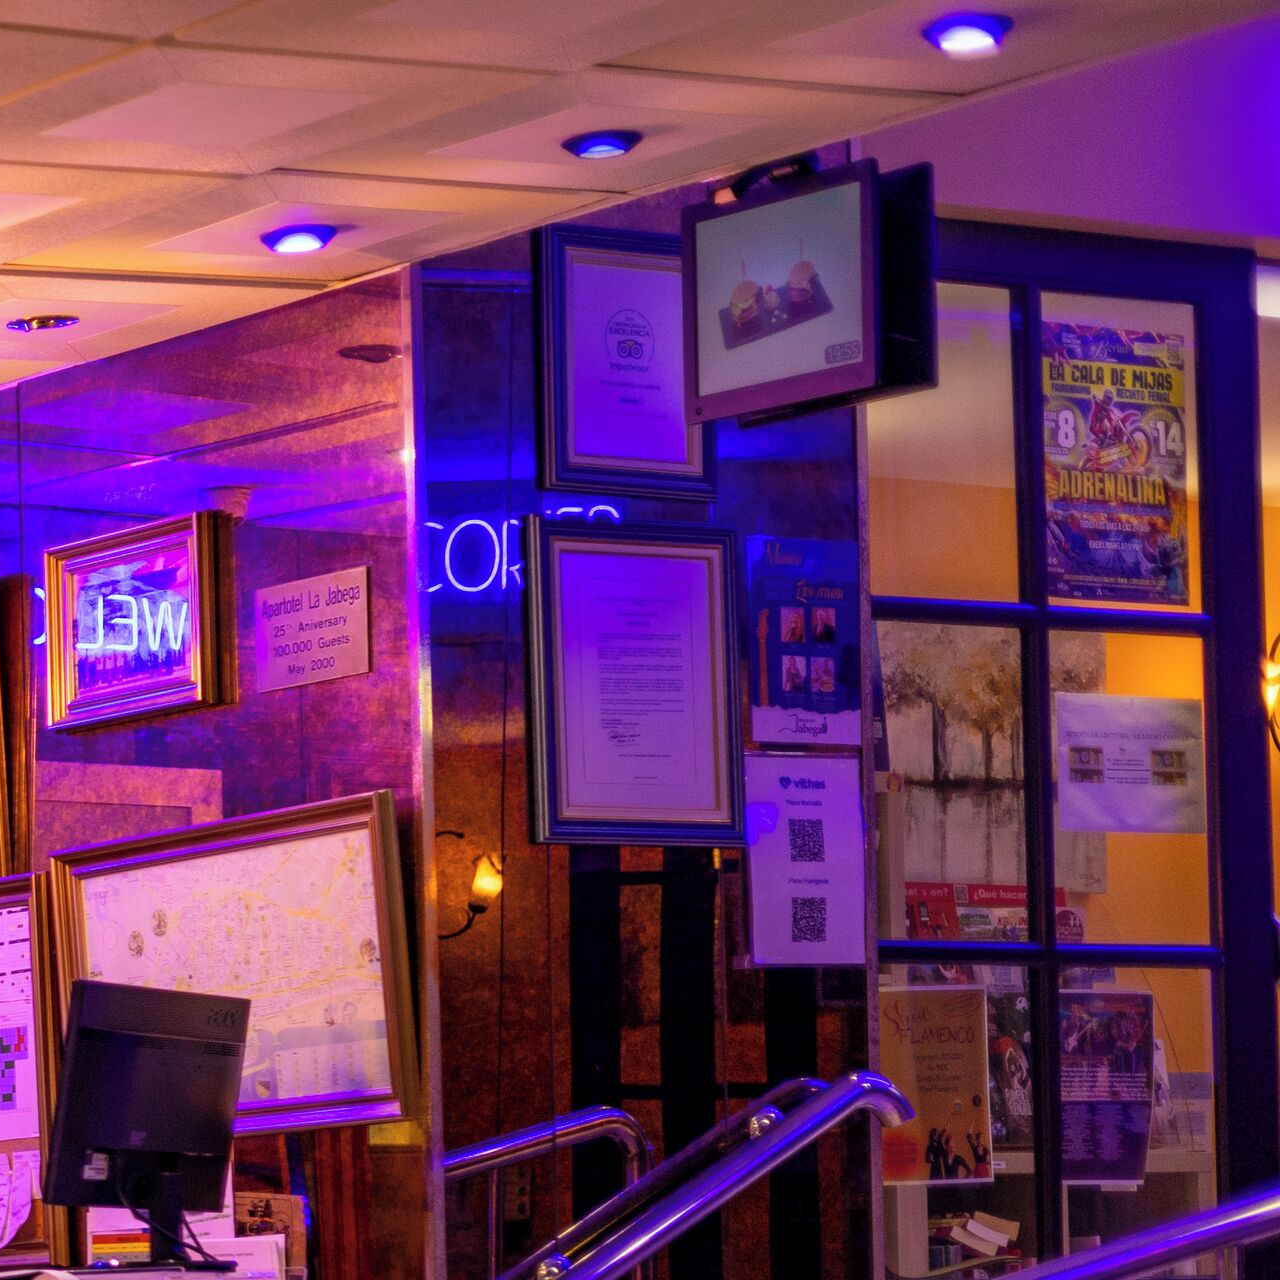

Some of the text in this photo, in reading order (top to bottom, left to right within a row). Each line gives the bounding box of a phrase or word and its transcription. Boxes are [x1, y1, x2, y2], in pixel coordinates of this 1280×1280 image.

[1071, 364, 1104, 385] CALA
[1111, 367, 1126, 387] DE
[1132, 370, 1173, 392] MIJAS
[1057, 409, 1076, 449] 8
[1156, 420, 1183, 456] 14
[1057, 468, 1167, 505] ADRENALINA
[262, 584, 360, 621] Apartotel La Jabega
[298, 615, 348, 633] Aniversary
[317, 634, 350, 649] Guests
[288, 656, 335, 675] May 2000
[794, 778, 826, 790] vithas
[973, 888, 998, 900] ¿Qué
[900, 1026, 975, 1045] FLAMENCO
